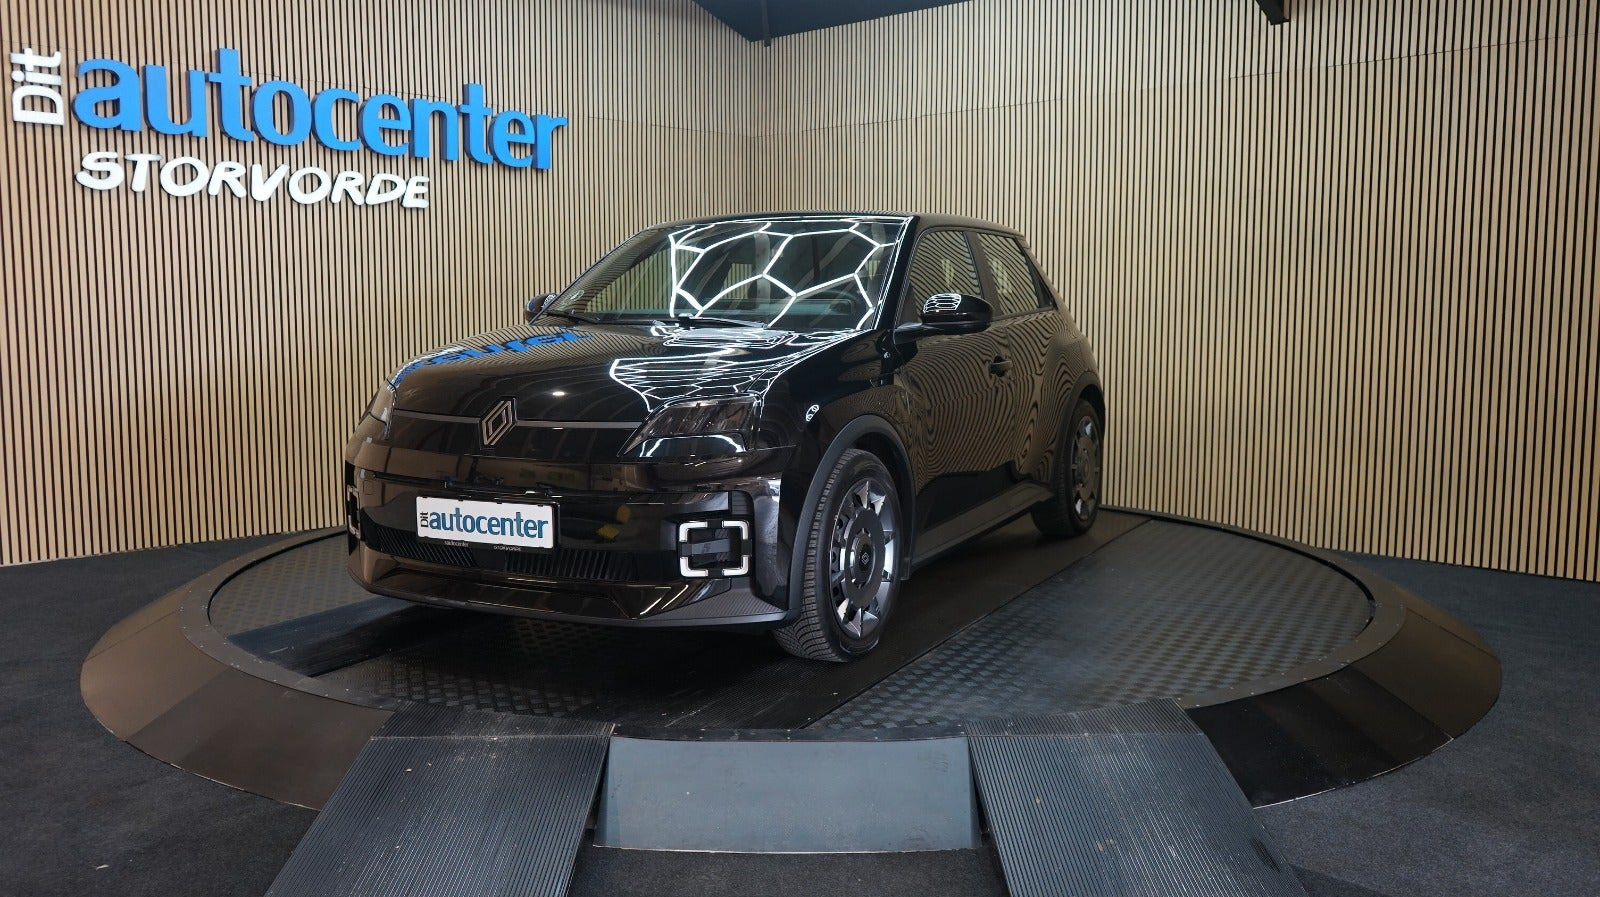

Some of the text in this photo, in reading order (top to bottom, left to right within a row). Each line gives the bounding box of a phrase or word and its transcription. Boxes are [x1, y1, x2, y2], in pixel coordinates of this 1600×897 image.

[10, 47, 64, 126] Dit
[72, 47, 568, 170] autocenter
[76, 151, 430, 208] STORVORDE
[420, 511, 429, 528] Dit
[429, 507, 549, 539] autocenter
